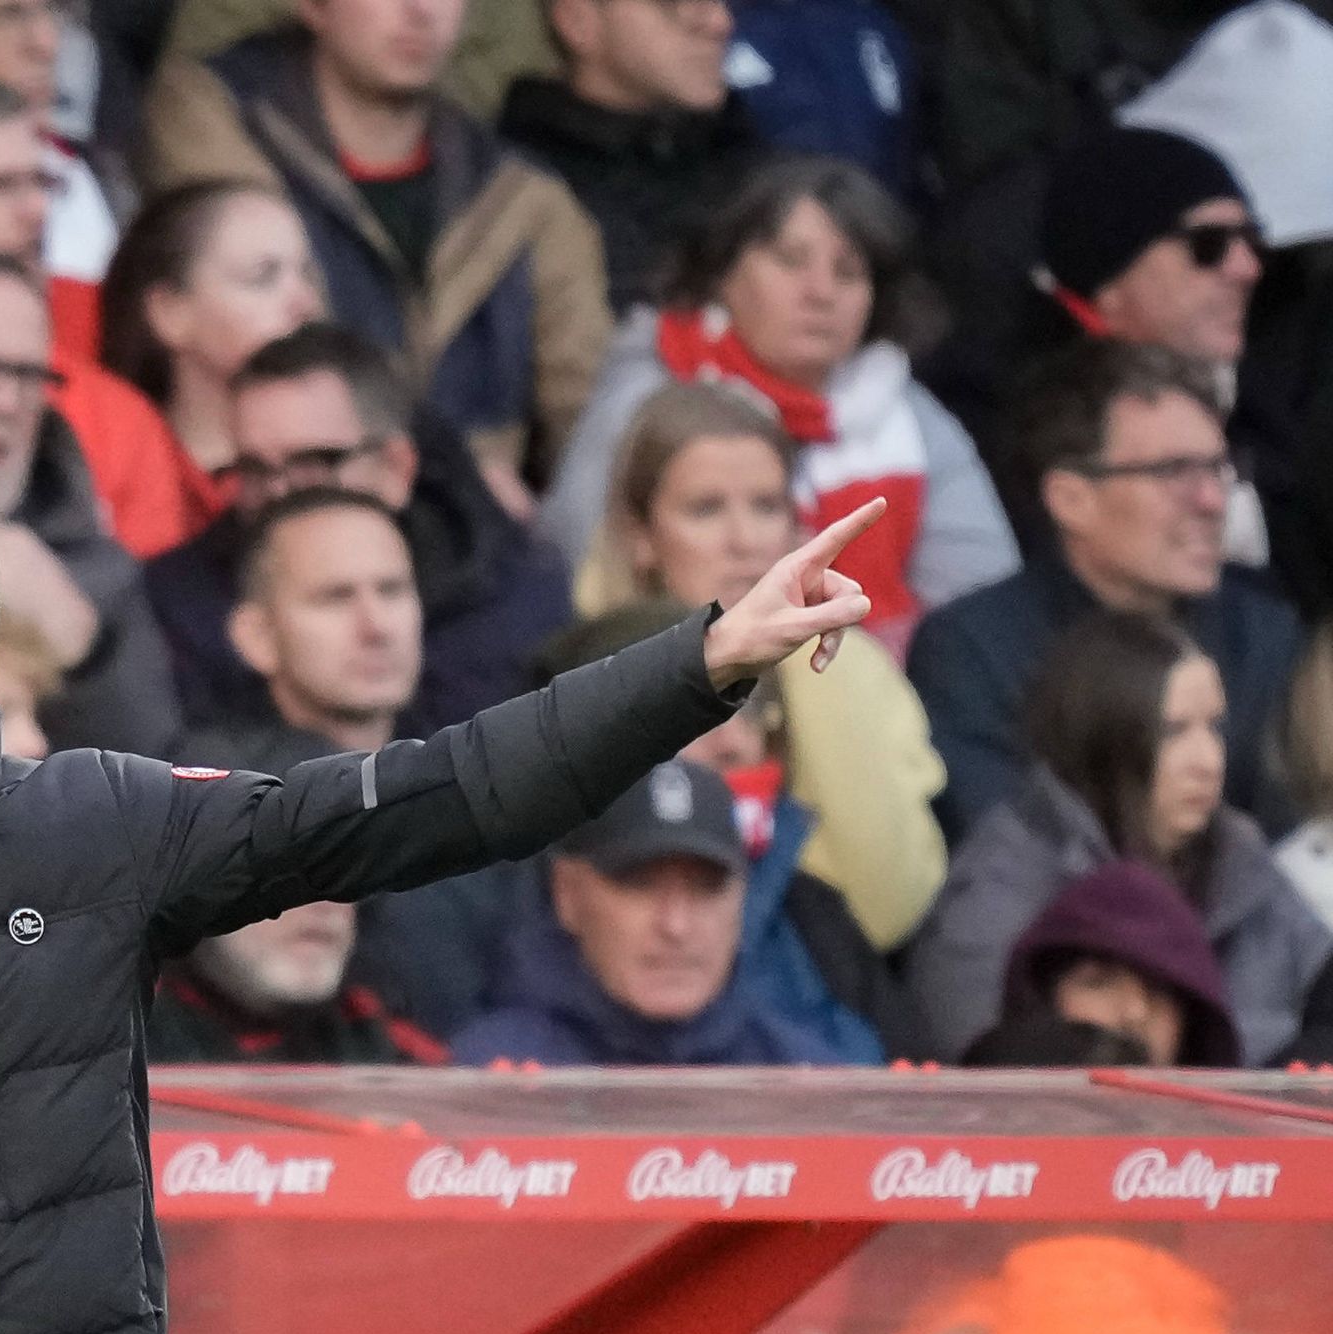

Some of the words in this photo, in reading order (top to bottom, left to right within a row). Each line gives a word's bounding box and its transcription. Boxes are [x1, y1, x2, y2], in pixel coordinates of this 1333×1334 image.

[162, 1142, 282, 1206] Bally
[407, 1145, 526, 1209] Bally
[626, 1147, 744, 1209] Bally
[870, 1147, 988, 1209] Bally
[1112, 1147, 1230, 1210] Bally
